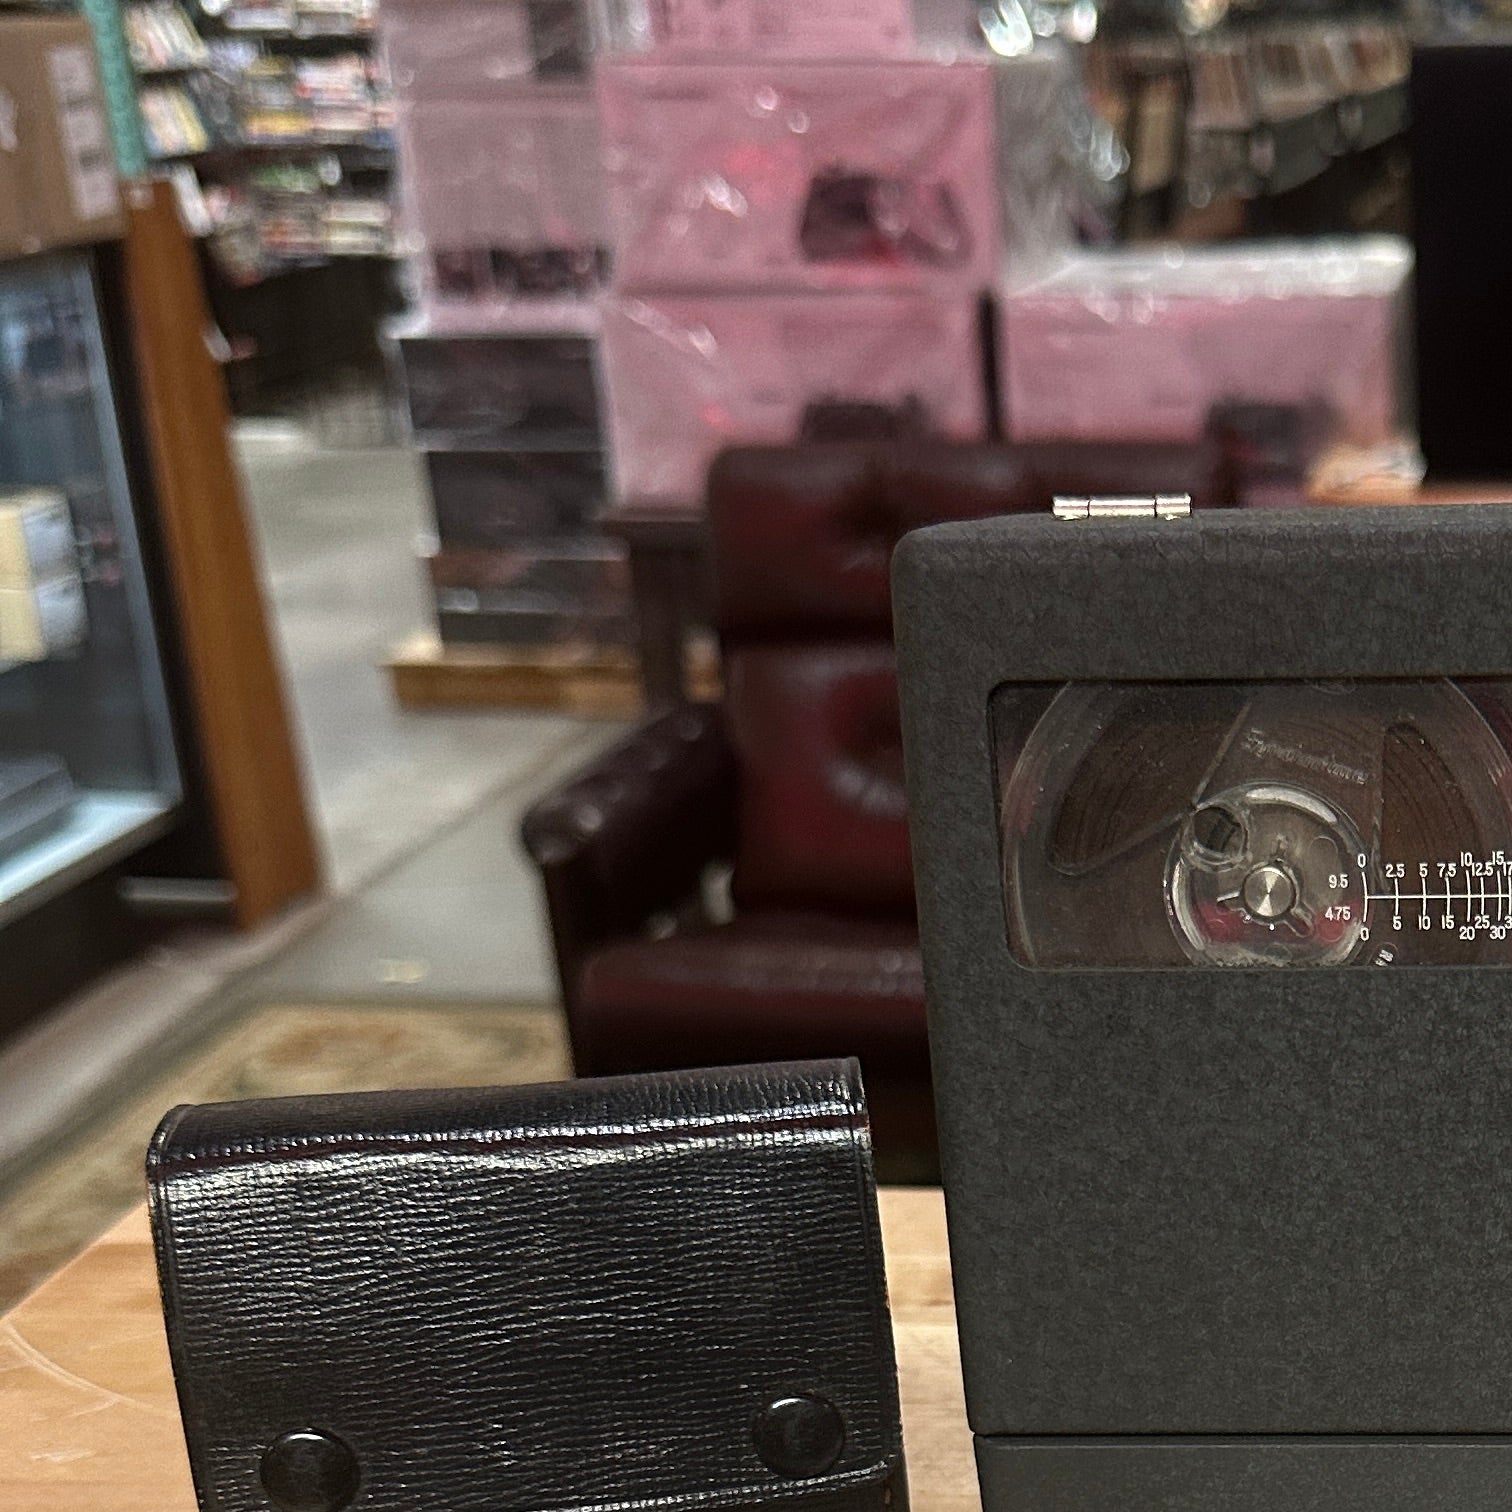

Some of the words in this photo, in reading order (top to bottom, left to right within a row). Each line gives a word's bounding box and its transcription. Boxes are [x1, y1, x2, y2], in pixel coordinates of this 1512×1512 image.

[1357, 853, 1367, 868] 0
[1385, 863, 1405, 878] 2.5
[1419, 863, 1428, 878] 5
[1437, 863, 1457, 878] 7.5
[1460, 851, 1473, 867] 10
[1471, 861, 1494, 876] 12.5
[1491, 850, 1505, 867] 15
[1328, 873, 1348, 889] 9.5
[1360, 926, 1370, 941] 0
[1392, 915, 1402, 931] 5
[1418, 914, 1431, 931] 10
[1441, 914, 1455, 930] 15
[1459, 925, 1476, 941] 20
[1474, 914, 1491, 930] 25
[1489, 925, 1506, 940] 30
